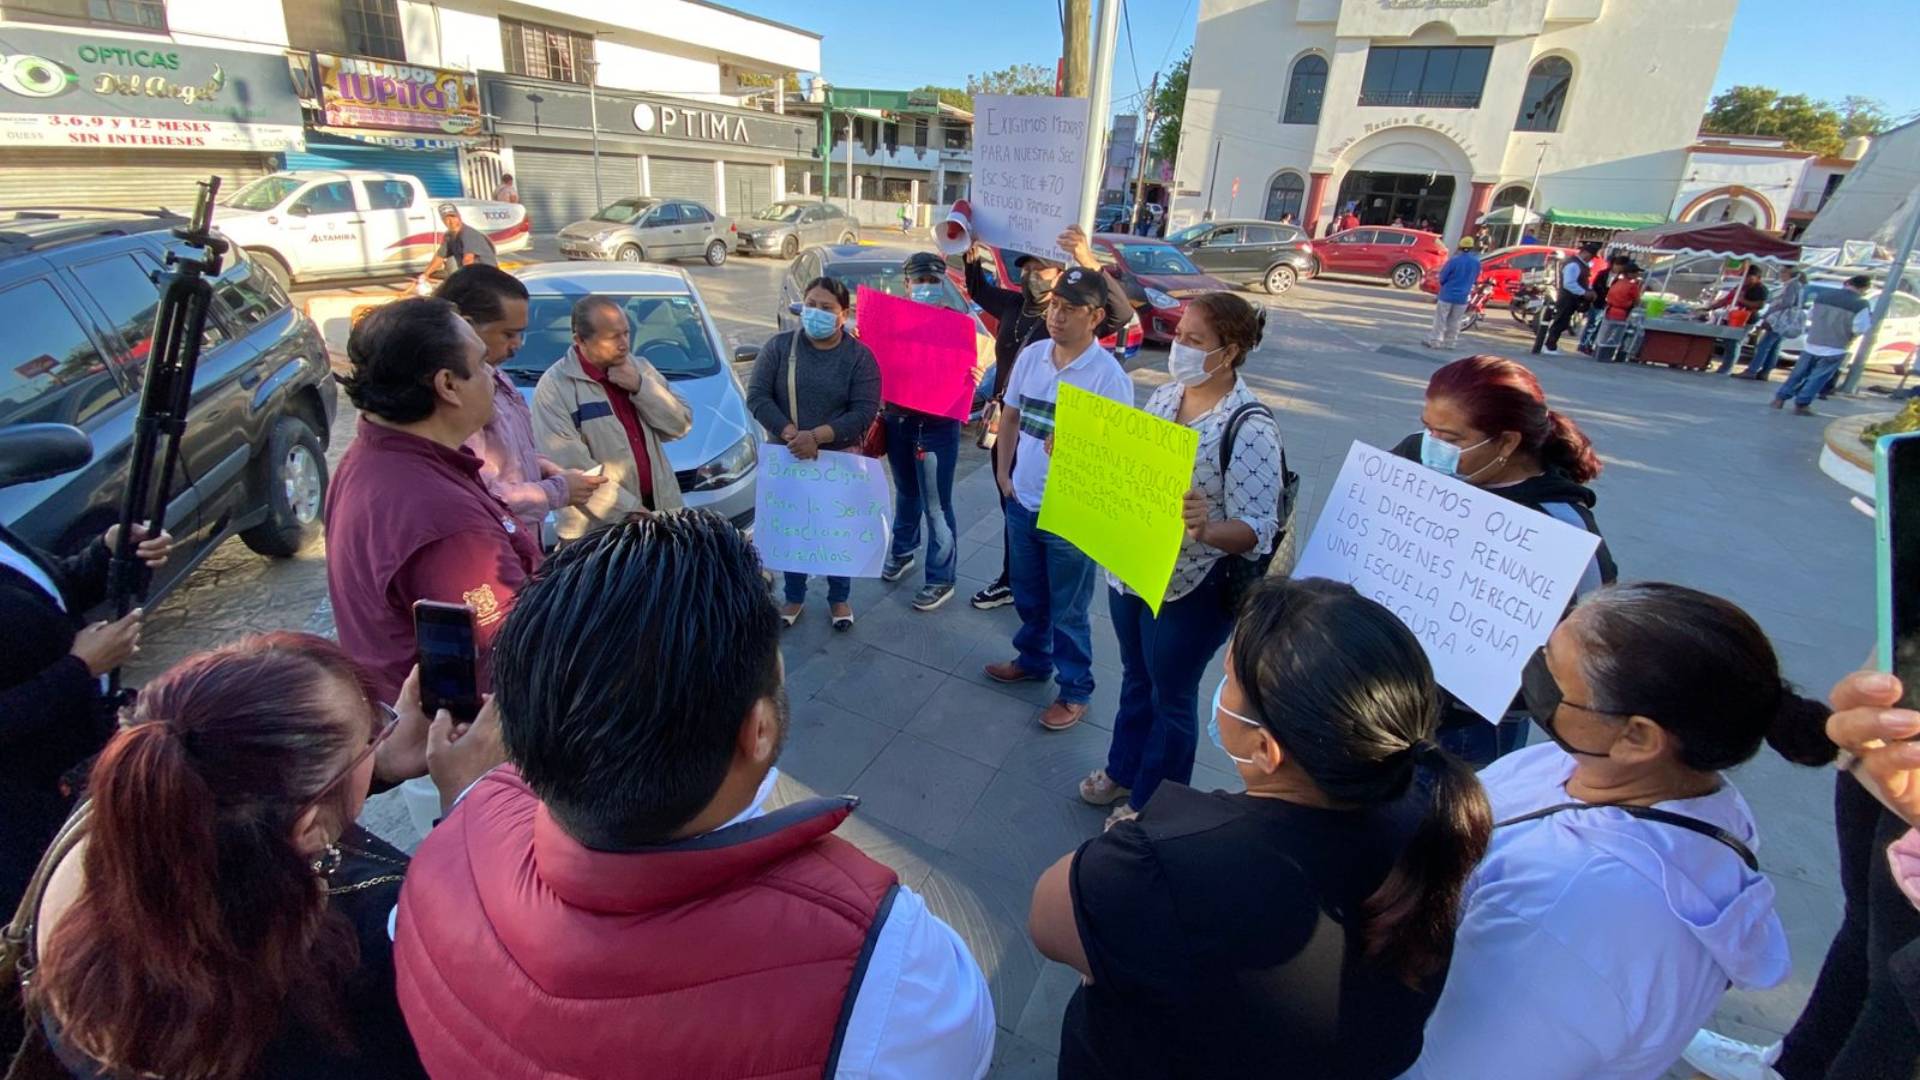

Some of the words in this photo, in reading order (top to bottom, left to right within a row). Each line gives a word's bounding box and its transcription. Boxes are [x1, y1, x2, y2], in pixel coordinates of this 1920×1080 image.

[78, 45, 181, 70] OPTICAS
[130, 118, 152, 129] 12
[157, 121, 212, 133] MESES
[68, 132, 101, 144] SIN
[107, 133, 206, 147] INTERESES
[980, 145, 1010, 162] PARA
[1013, 147, 1055, 163] NUESTRA
[310, 233, 357, 243] ALTAMIRA
[1358, 452, 1471, 519] "QUEREMOS
[1484, 511, 1539, 551] QUE
[1347, 482, 1367, 506] EL
[1377, 494, 1460, 548] DIRECTOR
[1470, 540, 1555, 601] RENUNCIE
[1336, 506, 1370, 537] LOS
[1378, 527, 1455, 580] JOVENES
[1458, 570, 1543, 631] MERECEN
[1326, 533, 1359, 562] UNA
[1363, 552, 1440, 606] ESCUELA
[1448, 601, 1520, 658] DIGNA
